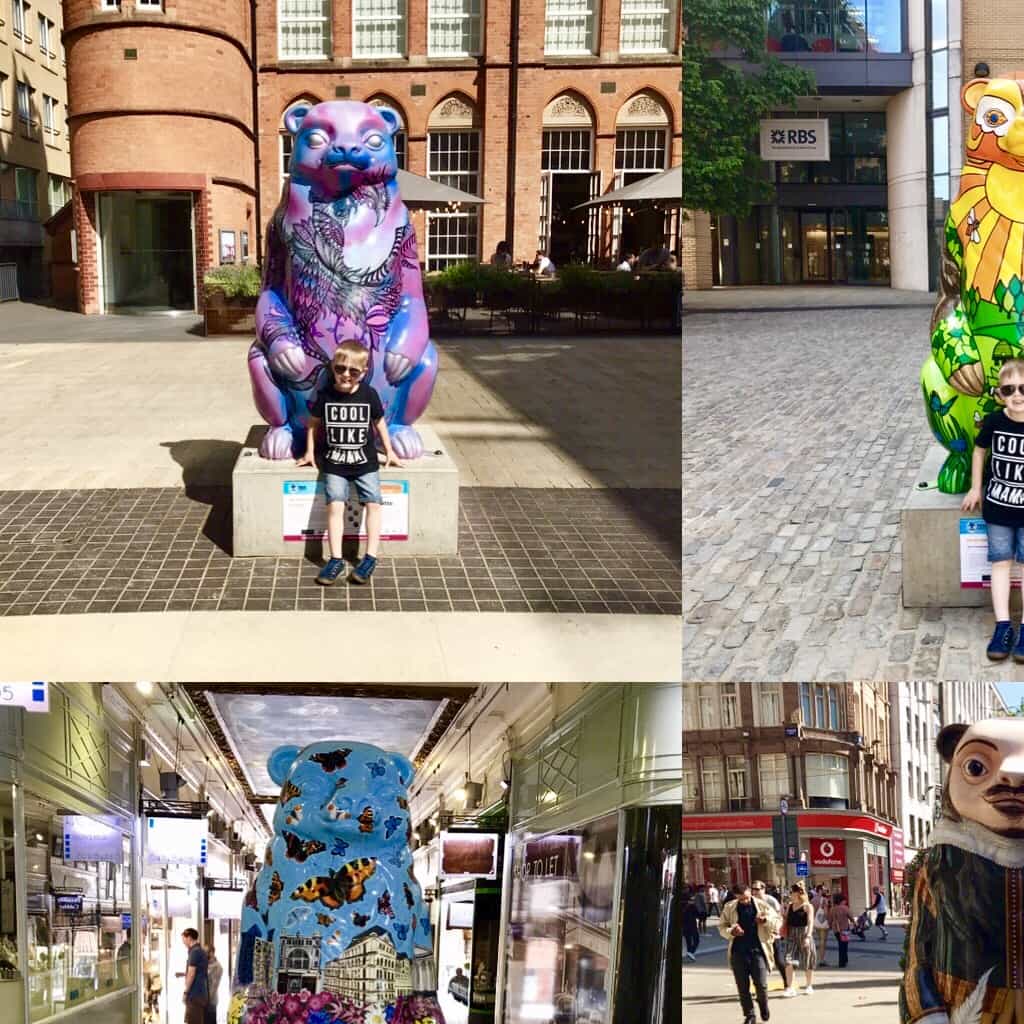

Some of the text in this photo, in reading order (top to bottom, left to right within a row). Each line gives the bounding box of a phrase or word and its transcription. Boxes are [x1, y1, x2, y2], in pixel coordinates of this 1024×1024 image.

[788, 129, 817, 144] RBS
[331, 406, 365, 421] COOL
[330, 428, 365, 443] LIKE
[0, 685, 14, 701] 5
[534, 860, 543, 879] TO
[545, 855, 559, 878] LET
